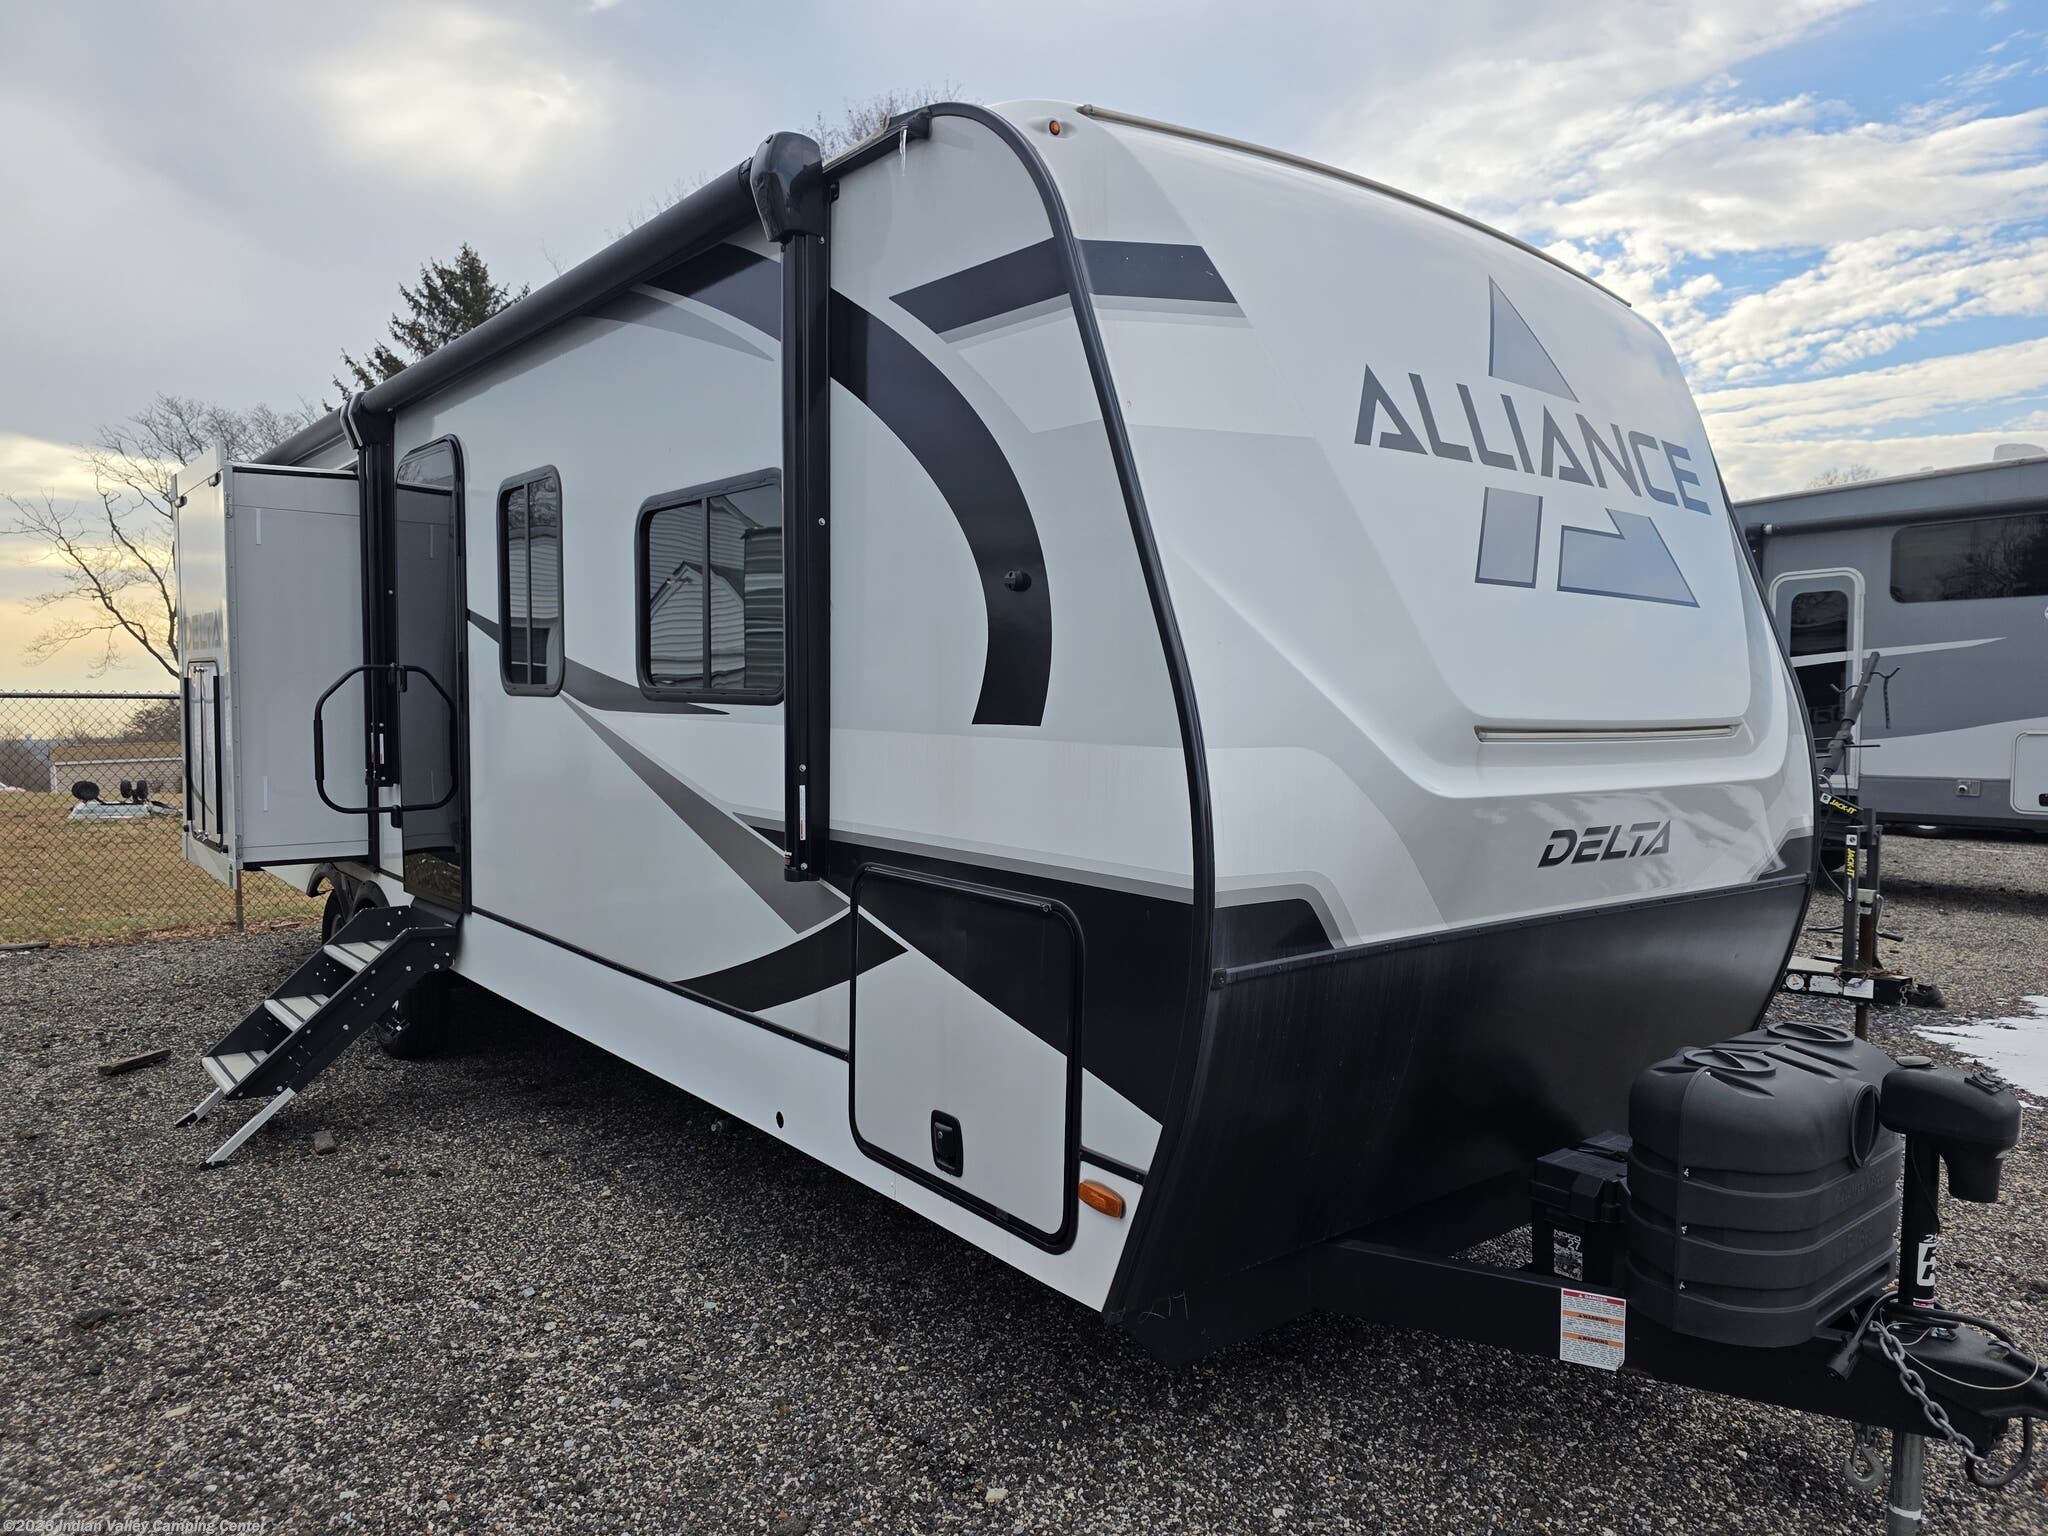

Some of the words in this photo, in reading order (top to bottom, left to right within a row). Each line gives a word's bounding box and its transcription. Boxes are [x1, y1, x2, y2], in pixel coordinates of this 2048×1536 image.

[1354, 363, 1712, 516] ALLIANCE
[1830, 799, 1858, 814] JACK-IT
[1537, 820, 1671, 868] DELTA
[1846, 848, 1855, 879] JACK-IT
[1554, 1229, 1581, 1241] NOCO
[1583, 1314, 1609, 1323] WARNING
[1583, 1335, 1609, 1345] WARNING
